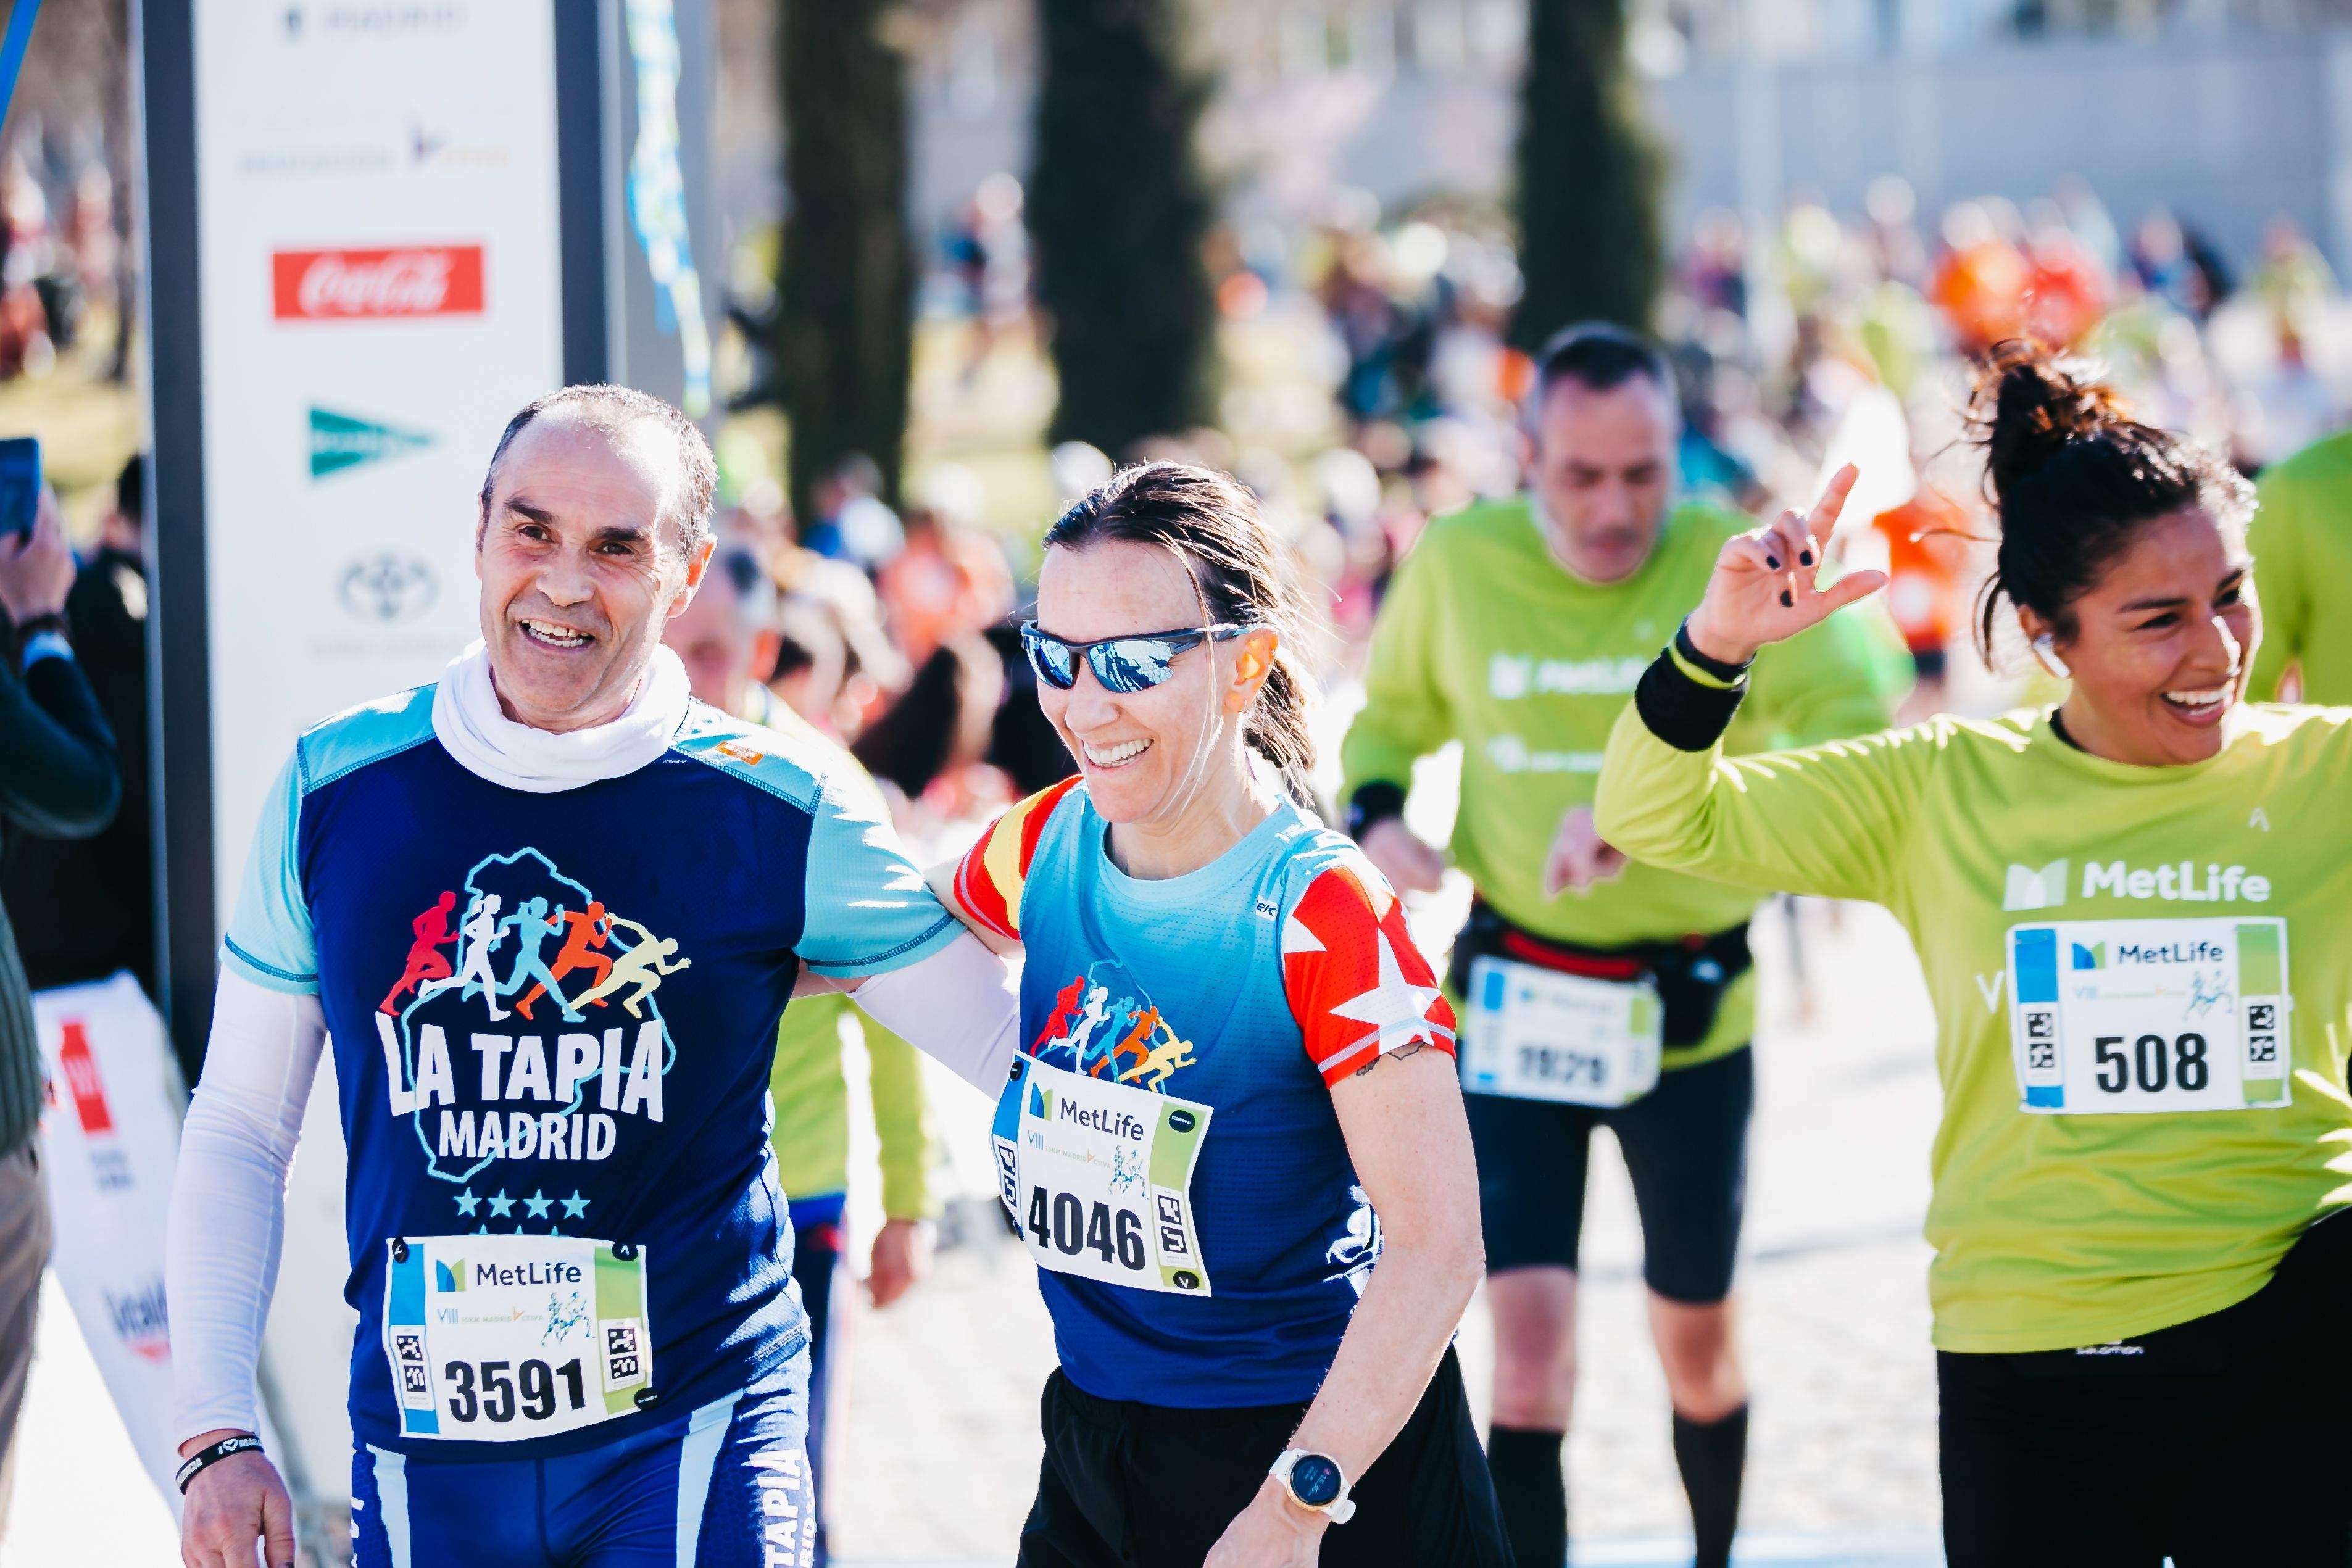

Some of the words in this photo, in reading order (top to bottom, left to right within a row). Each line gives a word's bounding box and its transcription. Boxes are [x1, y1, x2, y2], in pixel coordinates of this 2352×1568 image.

[2082, 860, 2271, 902] MetLife
[2118, 941, 2225, 965] MetLife
[375, 1011, 455, 1118] LA
[470, 1019, 663, 1123] TAPIA
[2094, 1032, 2209, 1094] 508
[439, 1110, 617, 1161] MADRID
[1028, 1130, 1044, 1150] VIII
[1060, 1098, 1144, 1141] MetLife
[1028, 1185, 1146, 1271] 4046
[477, 1262, 581, 1286] MetLife
[437, 1308, 459, 1324] VIII
[445, 1358, 586, 1423] 3591
[748, 1448, 802, 1568] TAPIA
